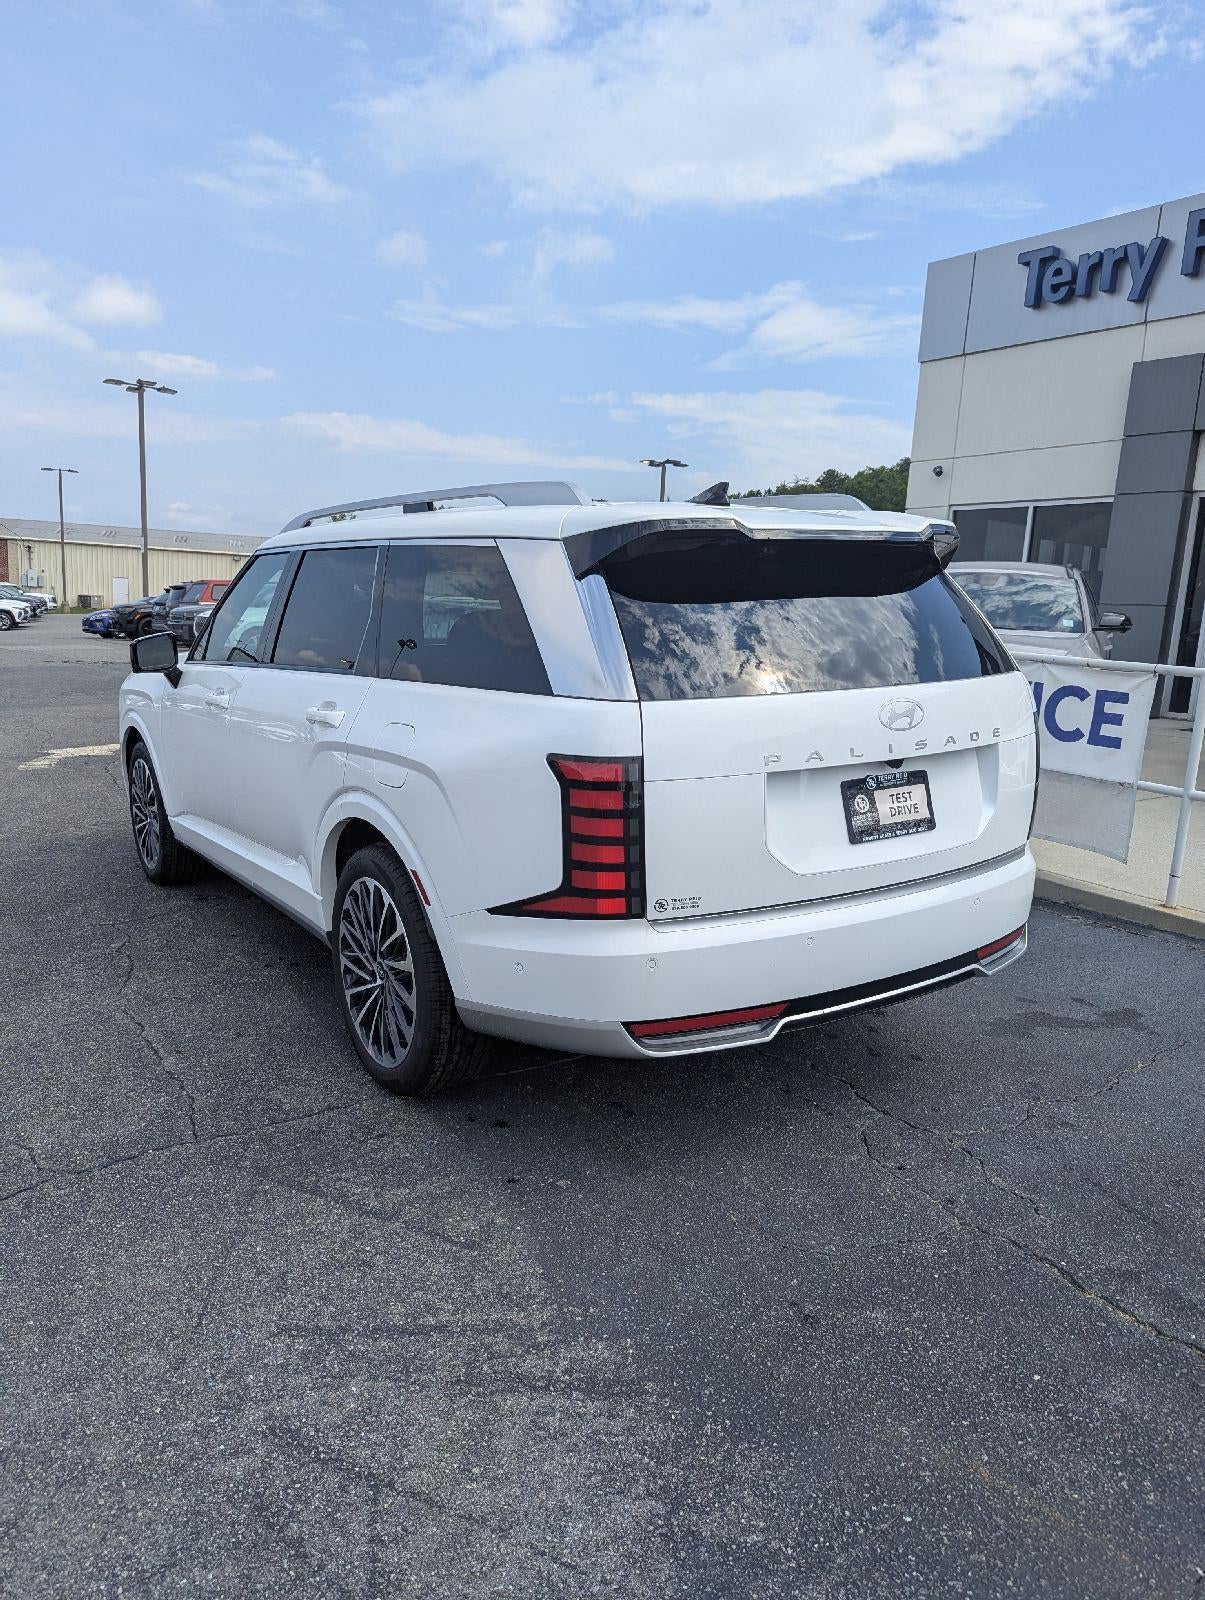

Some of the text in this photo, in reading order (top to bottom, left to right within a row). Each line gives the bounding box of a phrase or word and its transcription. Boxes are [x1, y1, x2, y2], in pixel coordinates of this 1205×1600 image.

[1018, 236, 1170, 310] Terry
[1029, 681, 1129, 749] ICE
[764, 727, 1001, 767] PALISADE
[889, 791, 912, 804] TEST
[889, 803, 919, 817] DRIVE
